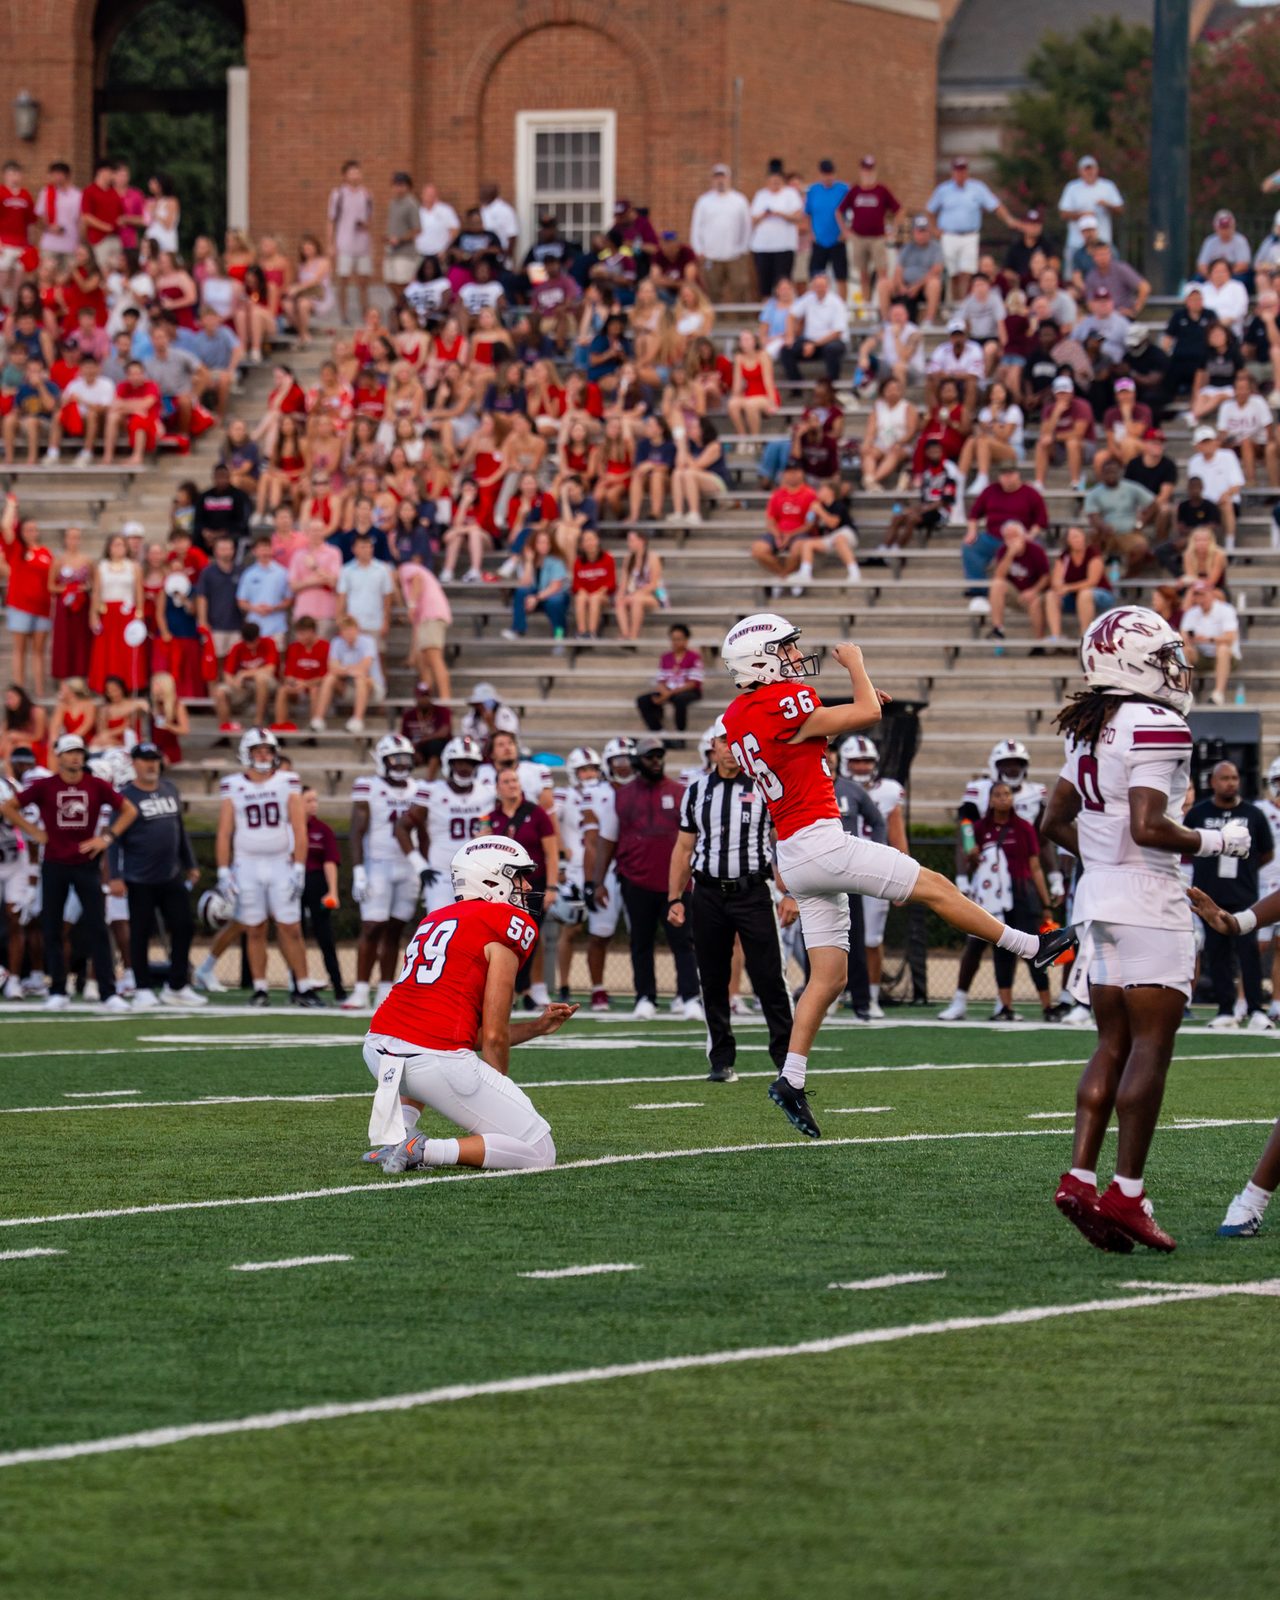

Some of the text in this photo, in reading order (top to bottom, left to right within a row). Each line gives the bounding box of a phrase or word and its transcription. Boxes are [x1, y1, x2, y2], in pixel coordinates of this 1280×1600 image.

[779, 690, 815, 719] 36
[1078, 754, 1106, 813] 0
[139, 796, 178, 818] SIU
[742, 811, 751, 824] R
[506, 914, 536, 951] 59
[397, 917, 459, 985] 59
